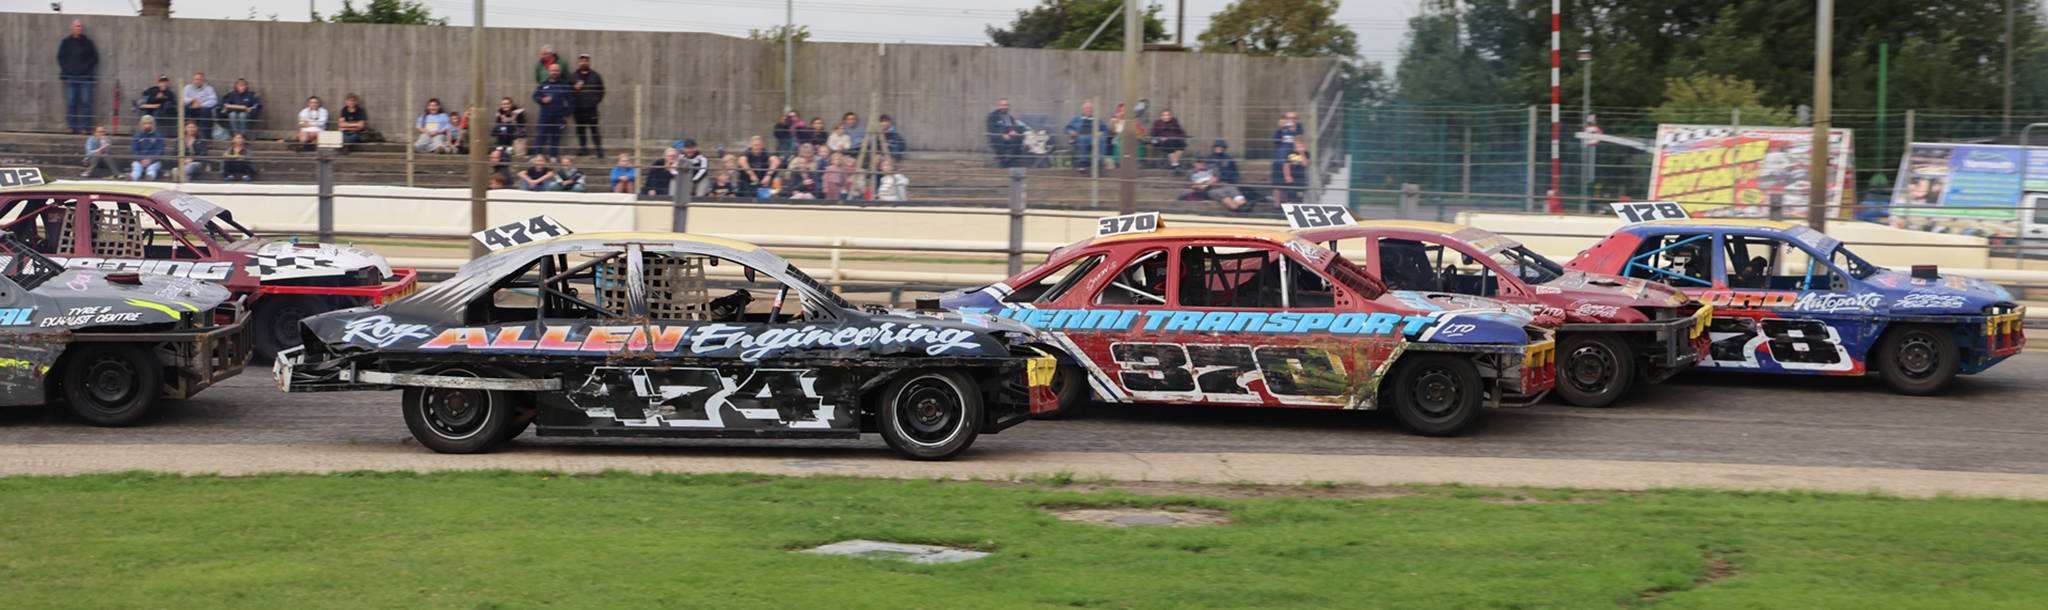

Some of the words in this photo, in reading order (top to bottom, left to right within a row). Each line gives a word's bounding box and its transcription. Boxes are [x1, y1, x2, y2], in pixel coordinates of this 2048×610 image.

[1288, 205, 1346, 228] 137
[1619, 203, 1685, 223] 178
[484, 215, 561, 248] 474
[1100, 214, 1156, 235] 370
[68, 305, 102, 316] TYRE
[1794, 291, 1885, 313] Autoparts
[40, 314, 96, 328] EXHAUST
[95, 312, 143, 323] CENTRE
[1143, 310, 1438, 337] TRANSPORT
[1442, 323, 1477, 334] LTD
[342, 315, 431, 348] Roy
[417, 325, 690, 352] ALLEN
[691, 322, 981, 362] Engineering
[1109, 341, 1352, 407] 370
[566, 366, 836, 428] 474
